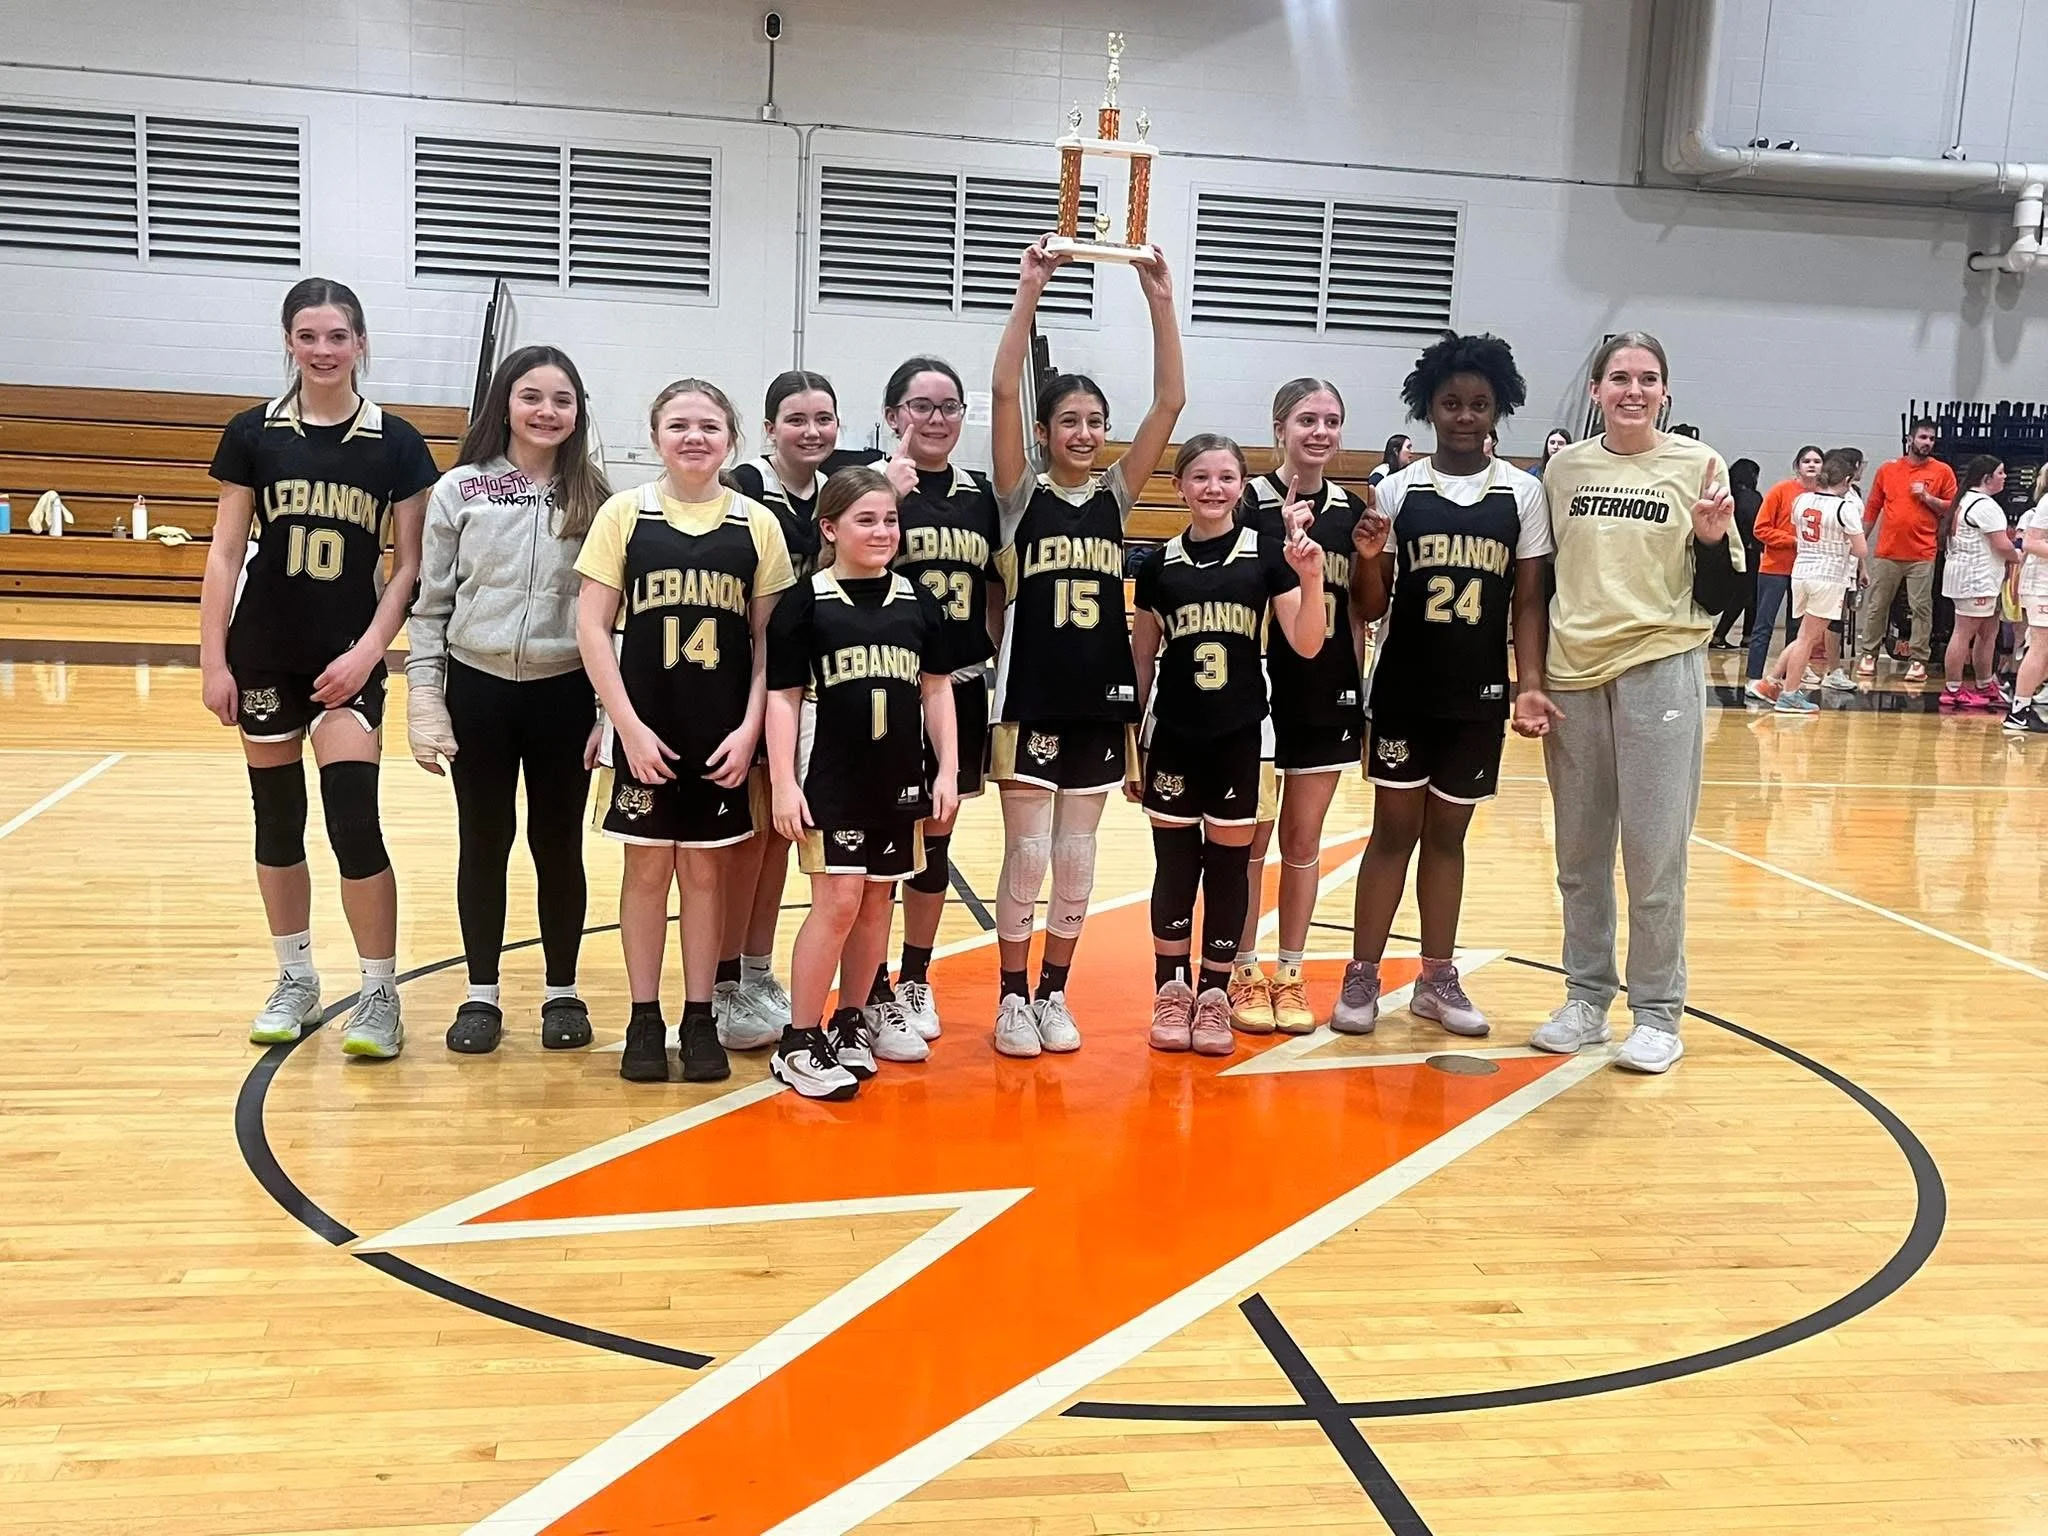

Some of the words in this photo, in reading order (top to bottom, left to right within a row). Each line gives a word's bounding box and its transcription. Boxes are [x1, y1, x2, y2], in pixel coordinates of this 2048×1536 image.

[263, 478, 379, 535] LEBANON
[459, 469, 533, 502] GHOST
[1568, 495, 1670, 524] SISTERHOOD
[1575, 485, 1611, 493] LEBANON
[1613, 486, 1665, 499] BASKETBALL
[892, 526, 989, 571] EBANO
[1801, 507, 1823, 543] 3
[286, 524, 345, 581] 10
[1023, 534, 1124, 581] LEBANON
[1407, 533, 1510, 579] LEBANON
[632, 568, 746, 617] LEBANON
[920, 569, 973, 621] 23
[1054, 578, 1100, 629] 15
[1425, 575, 1483, 625] 24
[663, 616, 720, 670] 14
[1166, 602, 1257, 641] LEBANON
[821, 644, 920, 689] LEBANON
[1193, 642, 1228, 691] 3
[871, 688, 888, 741] 1
